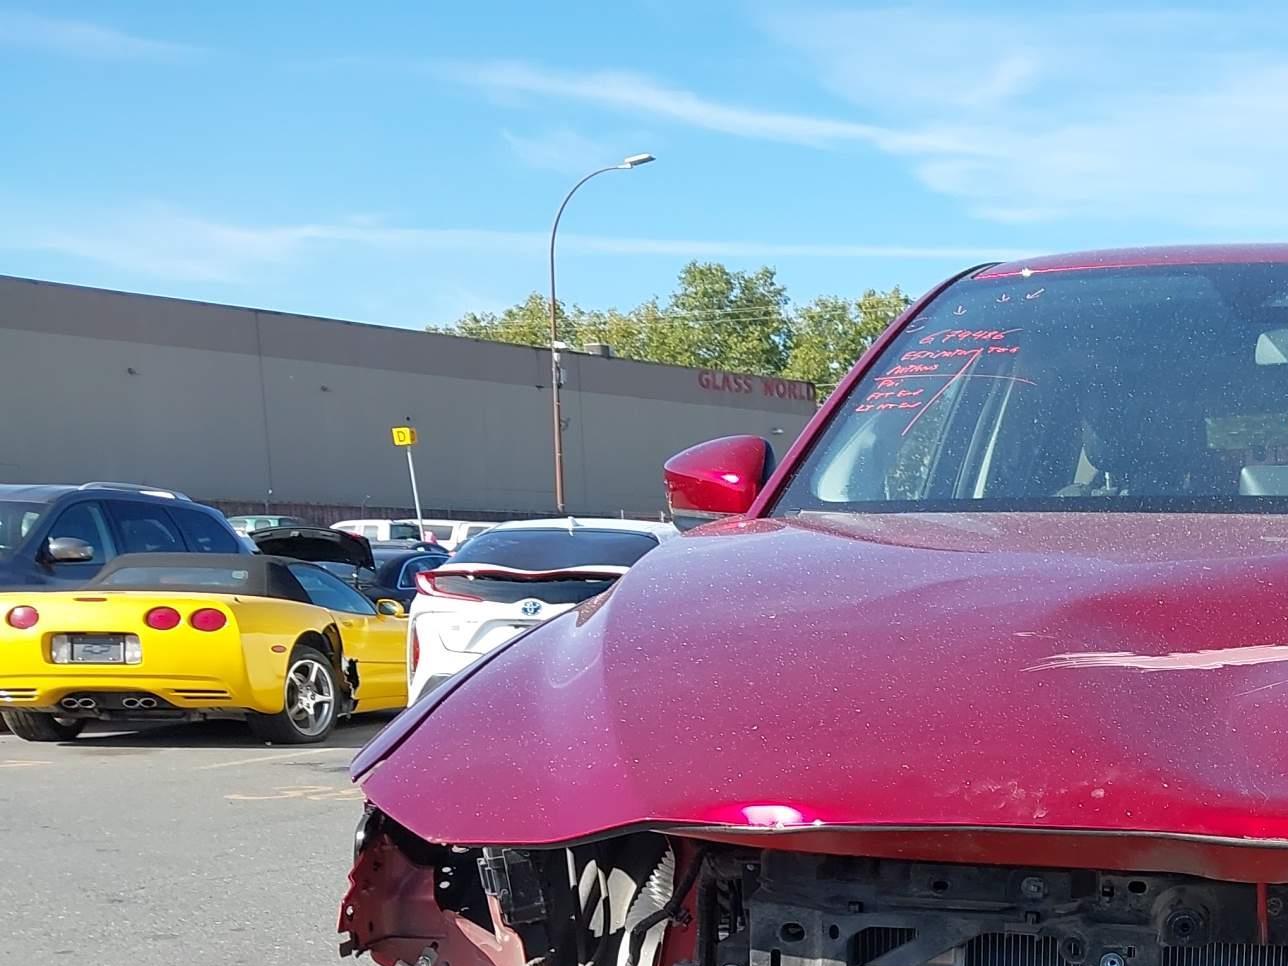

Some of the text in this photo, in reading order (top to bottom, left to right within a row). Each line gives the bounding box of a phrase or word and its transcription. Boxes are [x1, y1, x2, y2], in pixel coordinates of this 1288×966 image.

[697, 370, 816, 401] GLASS WORLD
[396, 430, 406, 443] D
